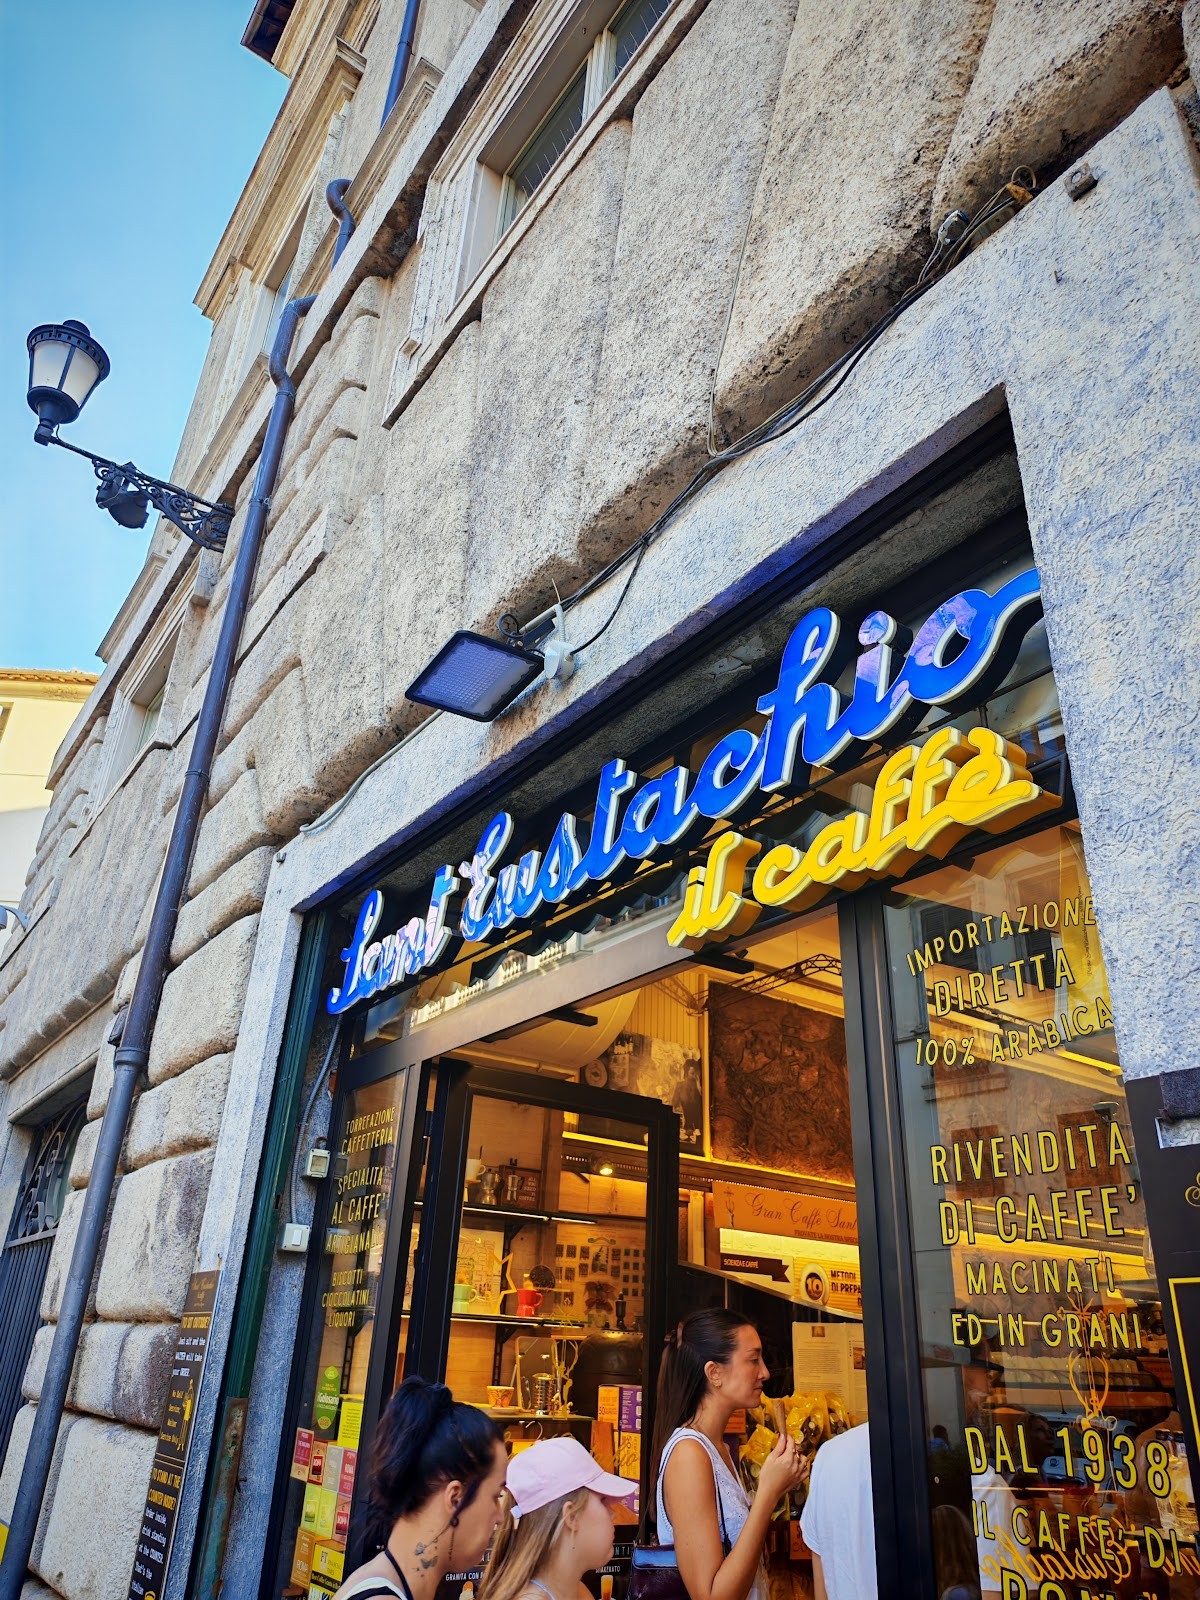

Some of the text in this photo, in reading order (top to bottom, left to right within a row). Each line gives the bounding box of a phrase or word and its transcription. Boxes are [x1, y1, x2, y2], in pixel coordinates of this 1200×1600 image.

[458, 568, 1041, 942] Eustachio
[666, 726, 1042, 947] il caffè
[906, 896, 1096, 977] IMPORTAZIONE
[934, 948, 1075, 1017] DIRETTA
[916, 997, 1113, 1066] 100% ARABICA
[341, 1126, 393, 1156] CAFFETTERIA
[346, 1107, 395, 1135] TORREFAZIONE
[930, 1121, 1132, 1184] RIVENDITA
[331, 1192, 386, 1225] AL CAFFE'
[744, 1193, 782, 1220] Gran
[939, 1185, 1136, 1246] DI CAFFE'
[322, 1289, 370, 1308] CIOCCOLATINI
[805, 1277, 824, 1296] 10
[966, 1257, 1116, 1295] MACINATI
[328, 1311, 356, 1328] LIQUORI
[951, 1313, 1142, 1349] ED IN GRANI
[965, 1424, 1171, 1499] DAL 1938
[971, 1499, 995, 1540] IL
[1143, 1525, 1183, 1574] DI
